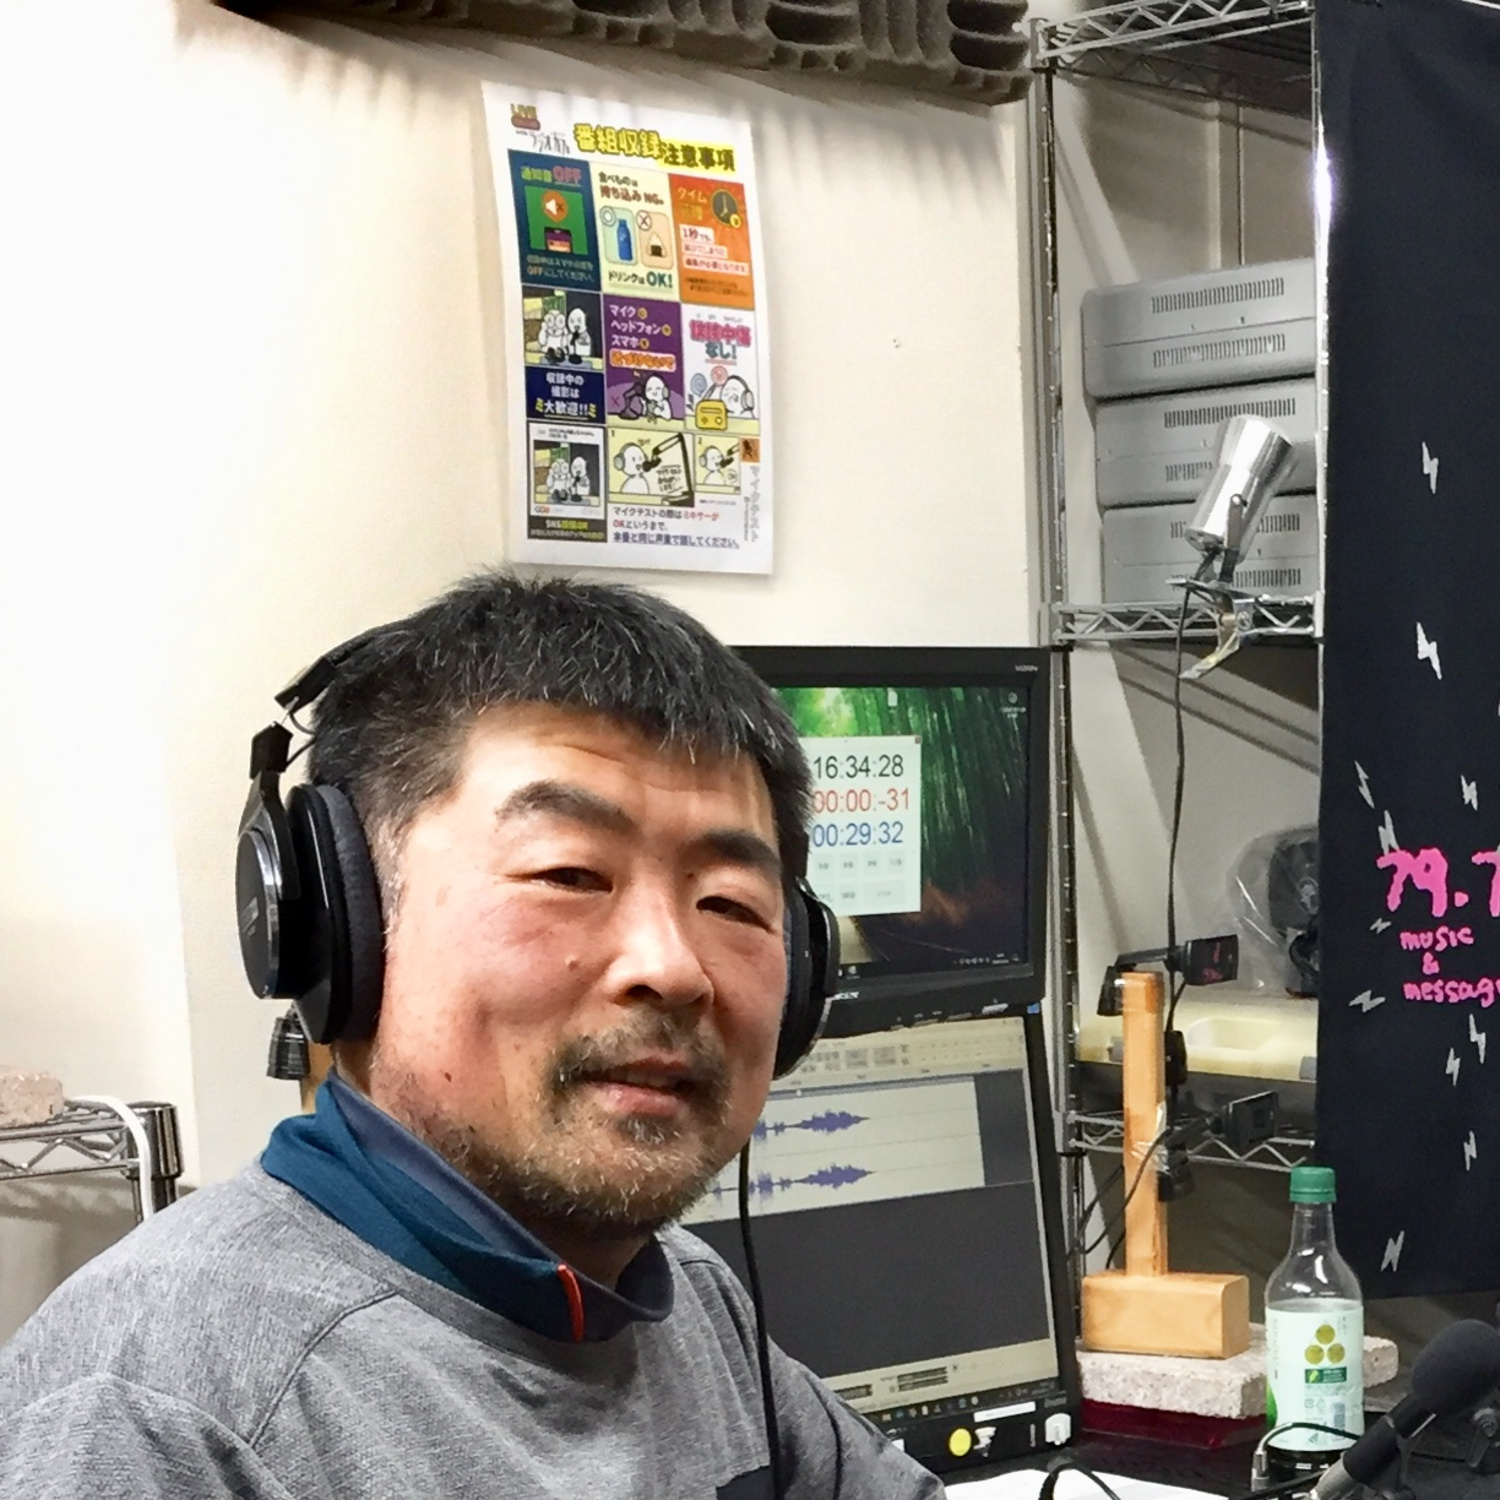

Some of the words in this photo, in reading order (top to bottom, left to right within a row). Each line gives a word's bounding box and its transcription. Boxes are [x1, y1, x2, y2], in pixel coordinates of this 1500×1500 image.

[813, 754, 904, 779] 16:34:28
[812, 821, 904, 847] 00:29:32
[1400, 925, 1474, 951] music
[1422, 951, 1440, 975] &
